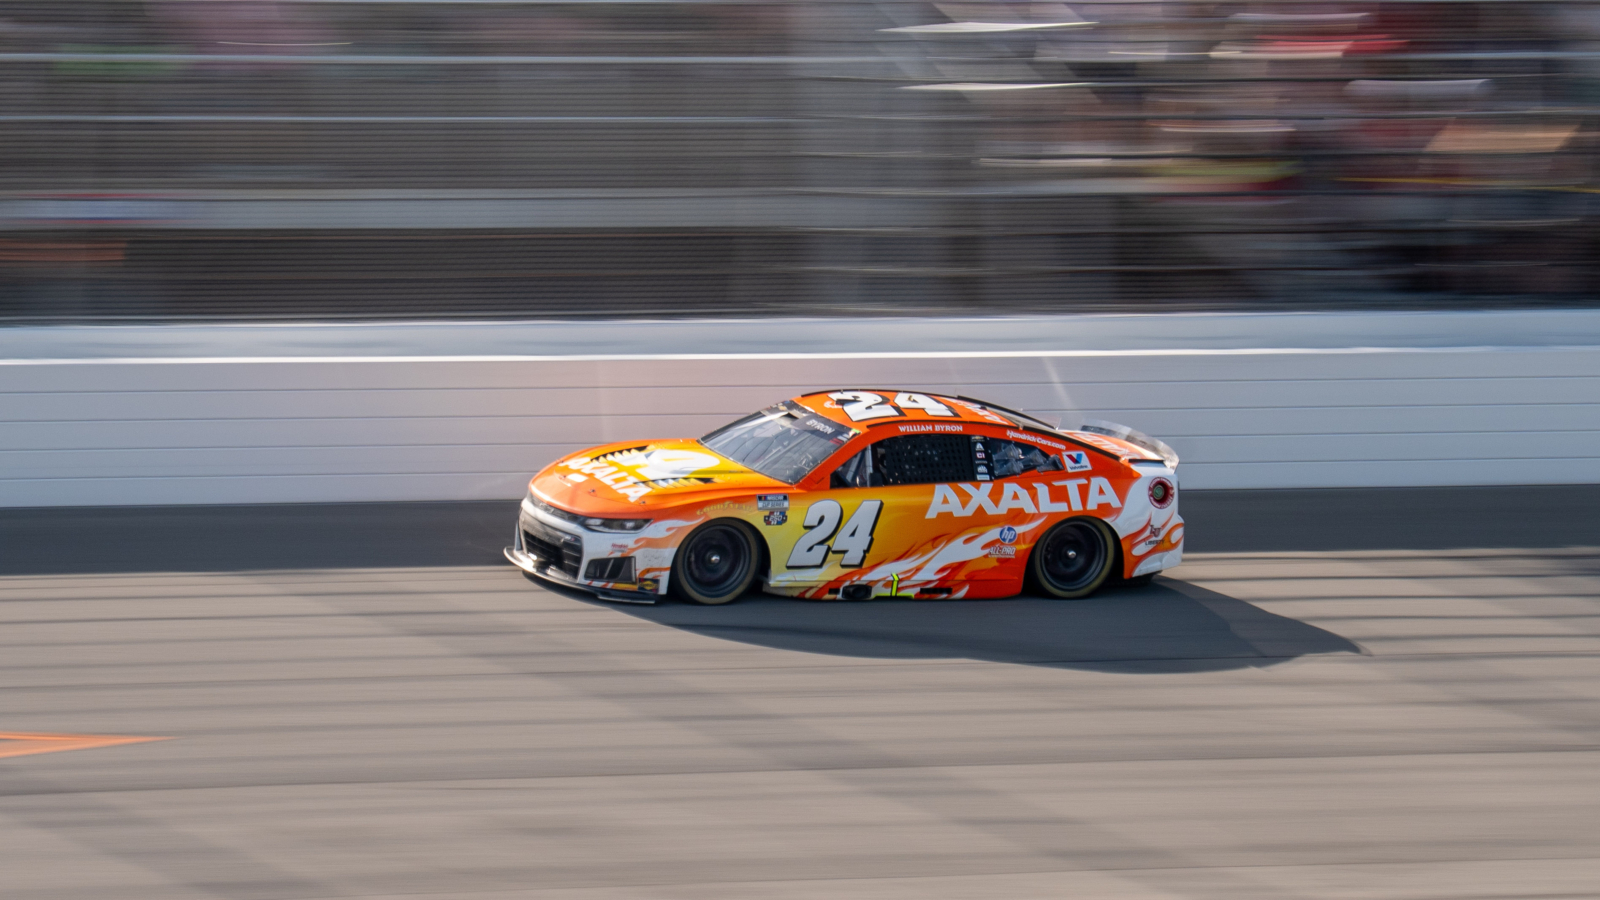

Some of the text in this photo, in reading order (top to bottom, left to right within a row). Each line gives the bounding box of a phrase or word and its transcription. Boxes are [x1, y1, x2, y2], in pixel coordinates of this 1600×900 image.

[827, 391, 957, 422] 24
[806, 419, 836, 435] BYRON
[935, 424, 963, 432] BYRON
[557, 457, 653, 503] AXALTA
[926, 476, 1123, 518] AXALTA
[786, 499, 884, 569] 24
[1002, 525, 1016, 544] hp
